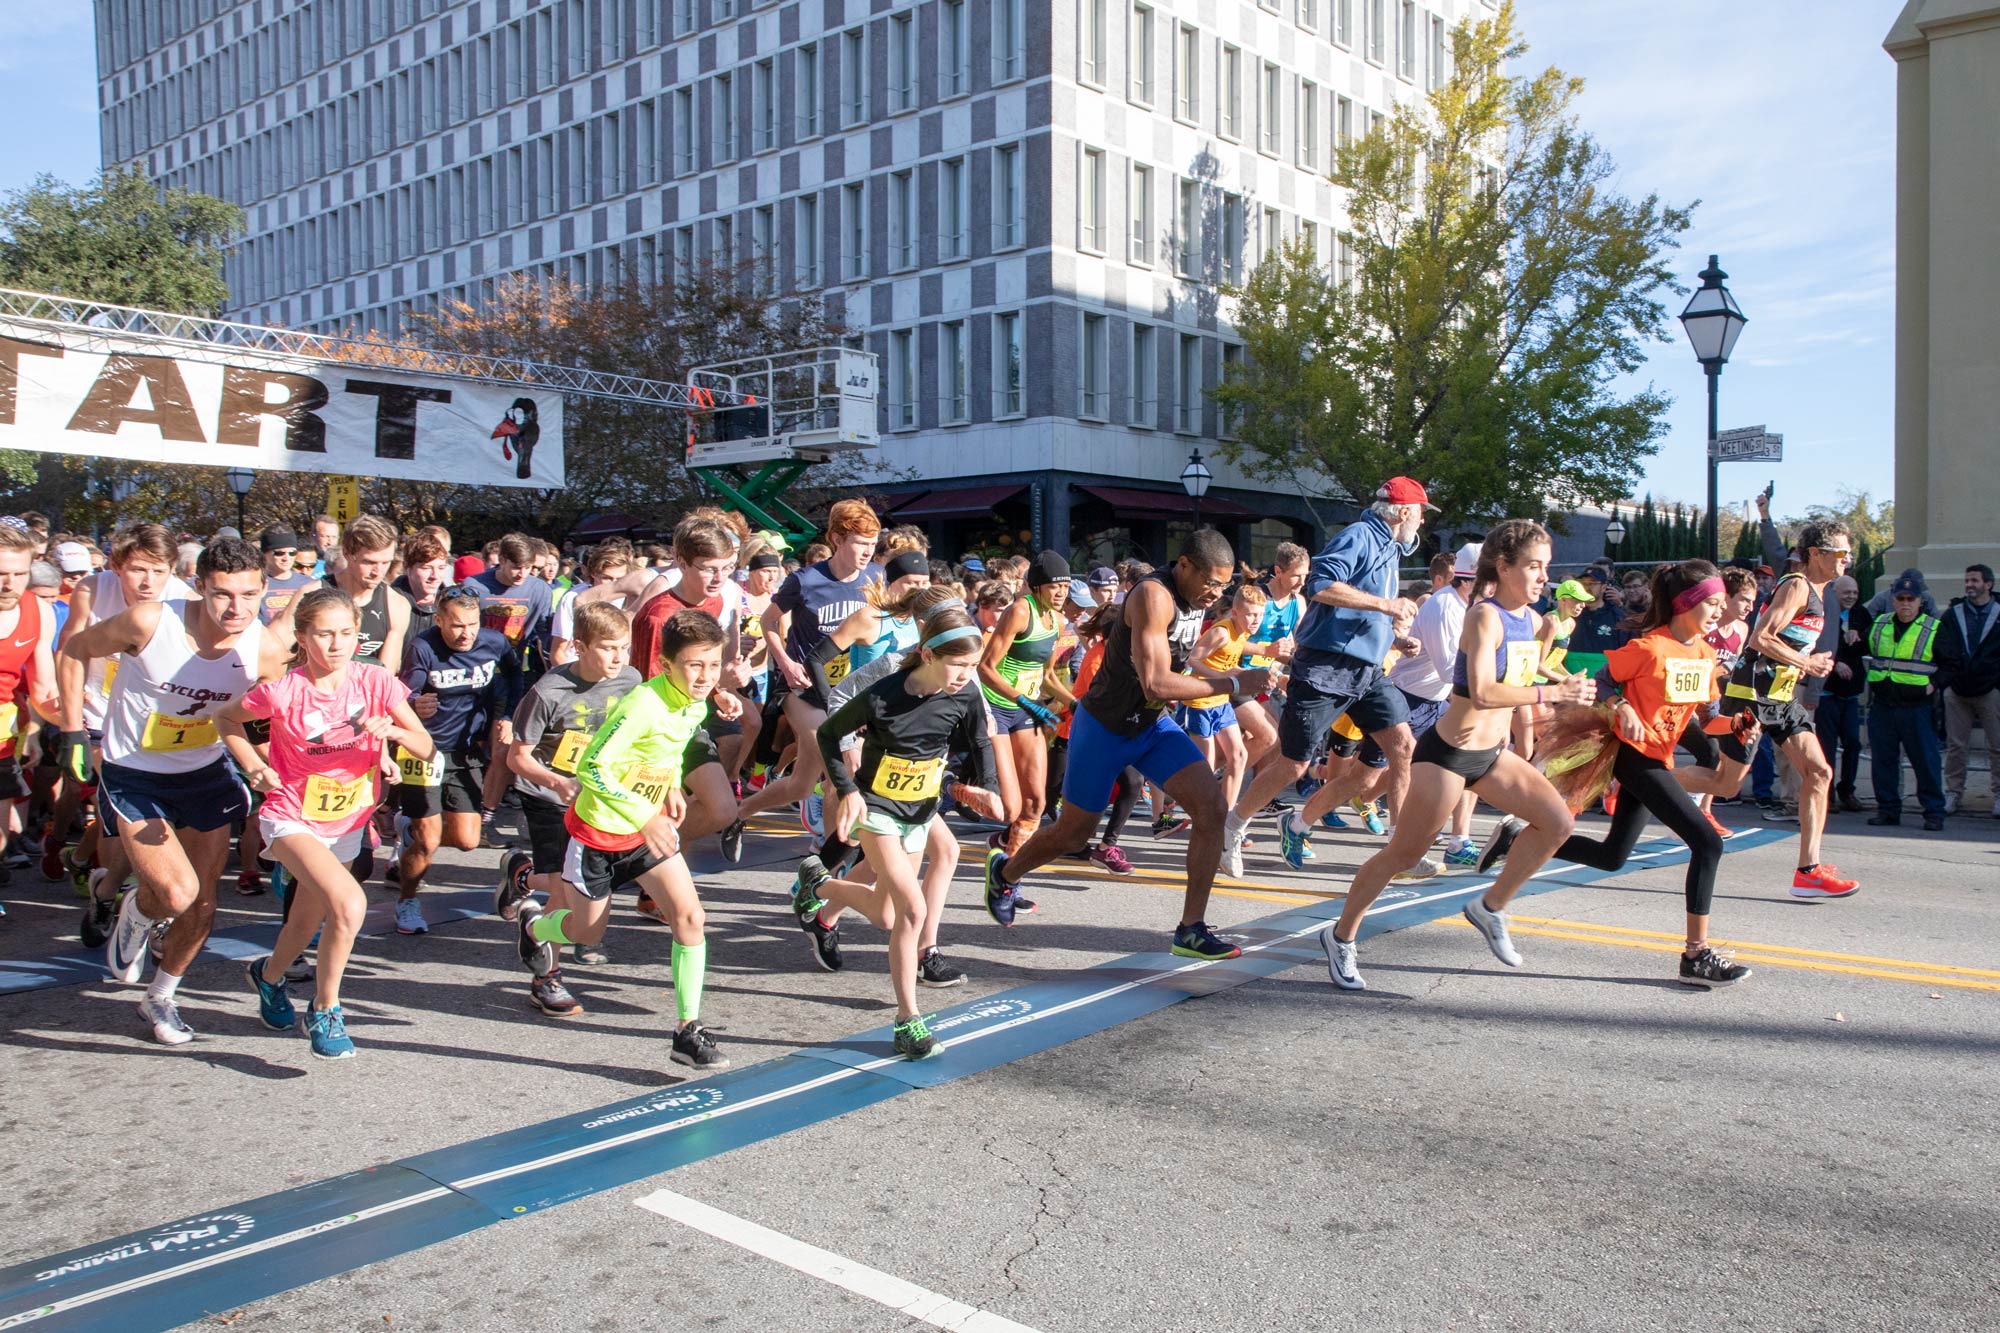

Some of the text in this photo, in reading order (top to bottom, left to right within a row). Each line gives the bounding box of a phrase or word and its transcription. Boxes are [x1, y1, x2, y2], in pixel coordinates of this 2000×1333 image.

[1720, 439, 1754, 455] MEETING
[818, 600, 869, 624] VILLANO
[1027, 682, 1035, 696] 8
[1675, 673, 1700, 691] 560
[172, 730, 185, 744] 1
[403, 759, 434, 776] 995
[886, 772, 926, 791] 873
[317, 791, 357, 812] 124
[650, 1094, 700, 1111] RM
[582, 1106, 655, 1129] TIMING
[34, 1223, 219, 1282] RM TIMING
